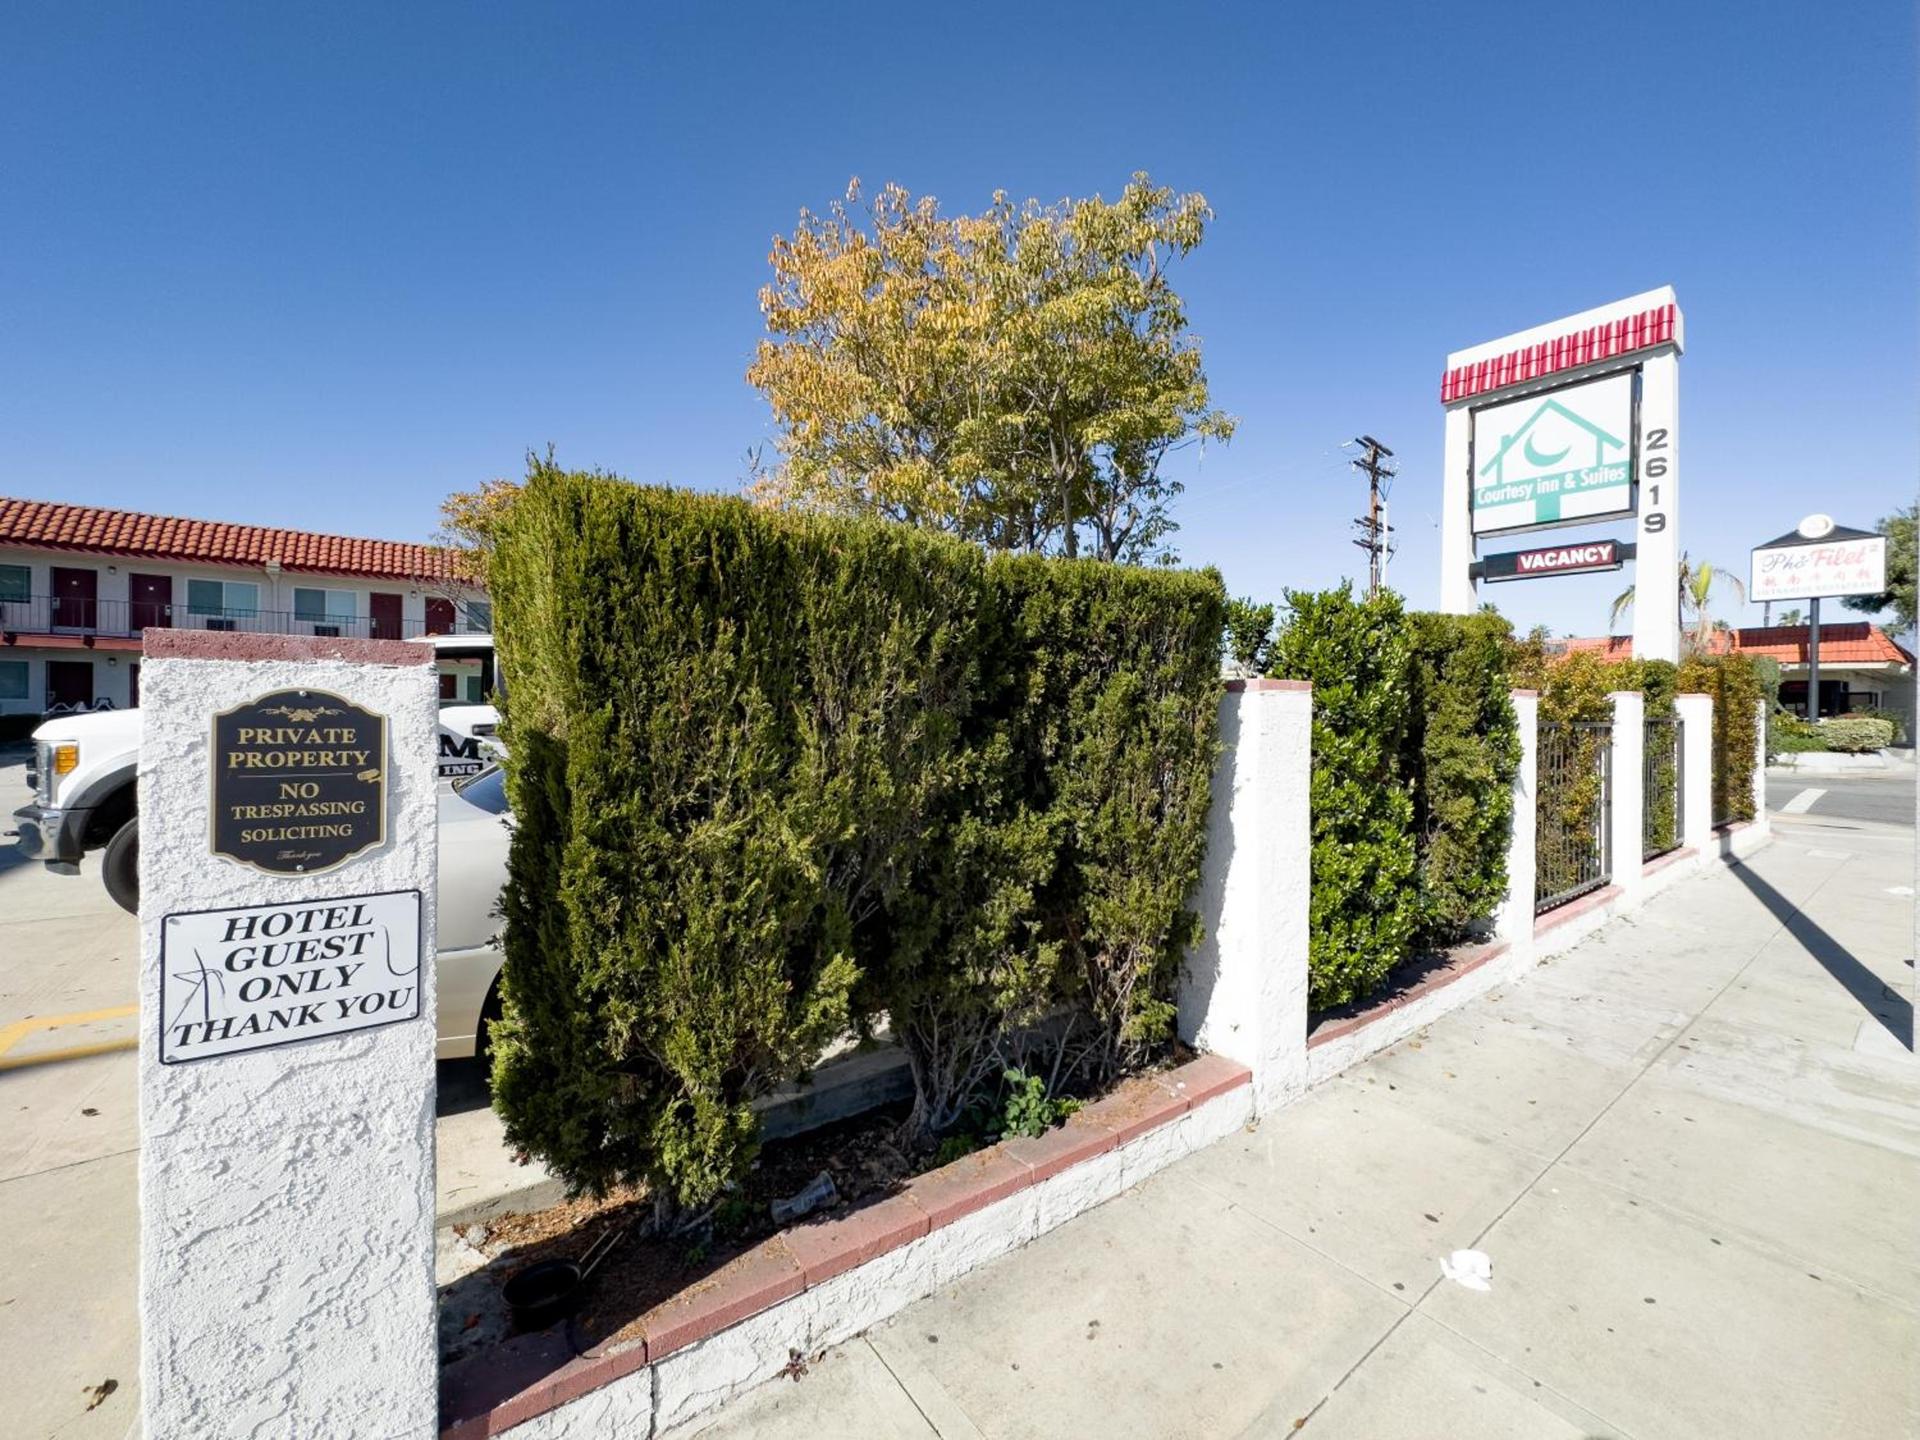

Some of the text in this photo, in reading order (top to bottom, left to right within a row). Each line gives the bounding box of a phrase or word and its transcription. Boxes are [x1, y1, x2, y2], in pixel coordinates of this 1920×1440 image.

[1477, 484, 1534, 505] Courtesy
[1563, 472, 1577, 489] &
[1580, 466, 1626, 487] Suites
[1645, 428, 1668, 533] 2619
[1520, 544, 1613, 569] VACANCY
[237, 728, 357, 745] PRIVATE
[227, 750, 371, 769] PROPERTY
[279, 782, 320, 800] NO
[231, 800, 366, 820] TRESPASSING
[241, 823, 353, 843] SOLICITING
[219, 903, 374, 943] HOTEL
[224, 931, 375, 973] GUEST
[238, 962, 365, 1003] ONLY
[173, 986, 415, 1048] THANK YOU
